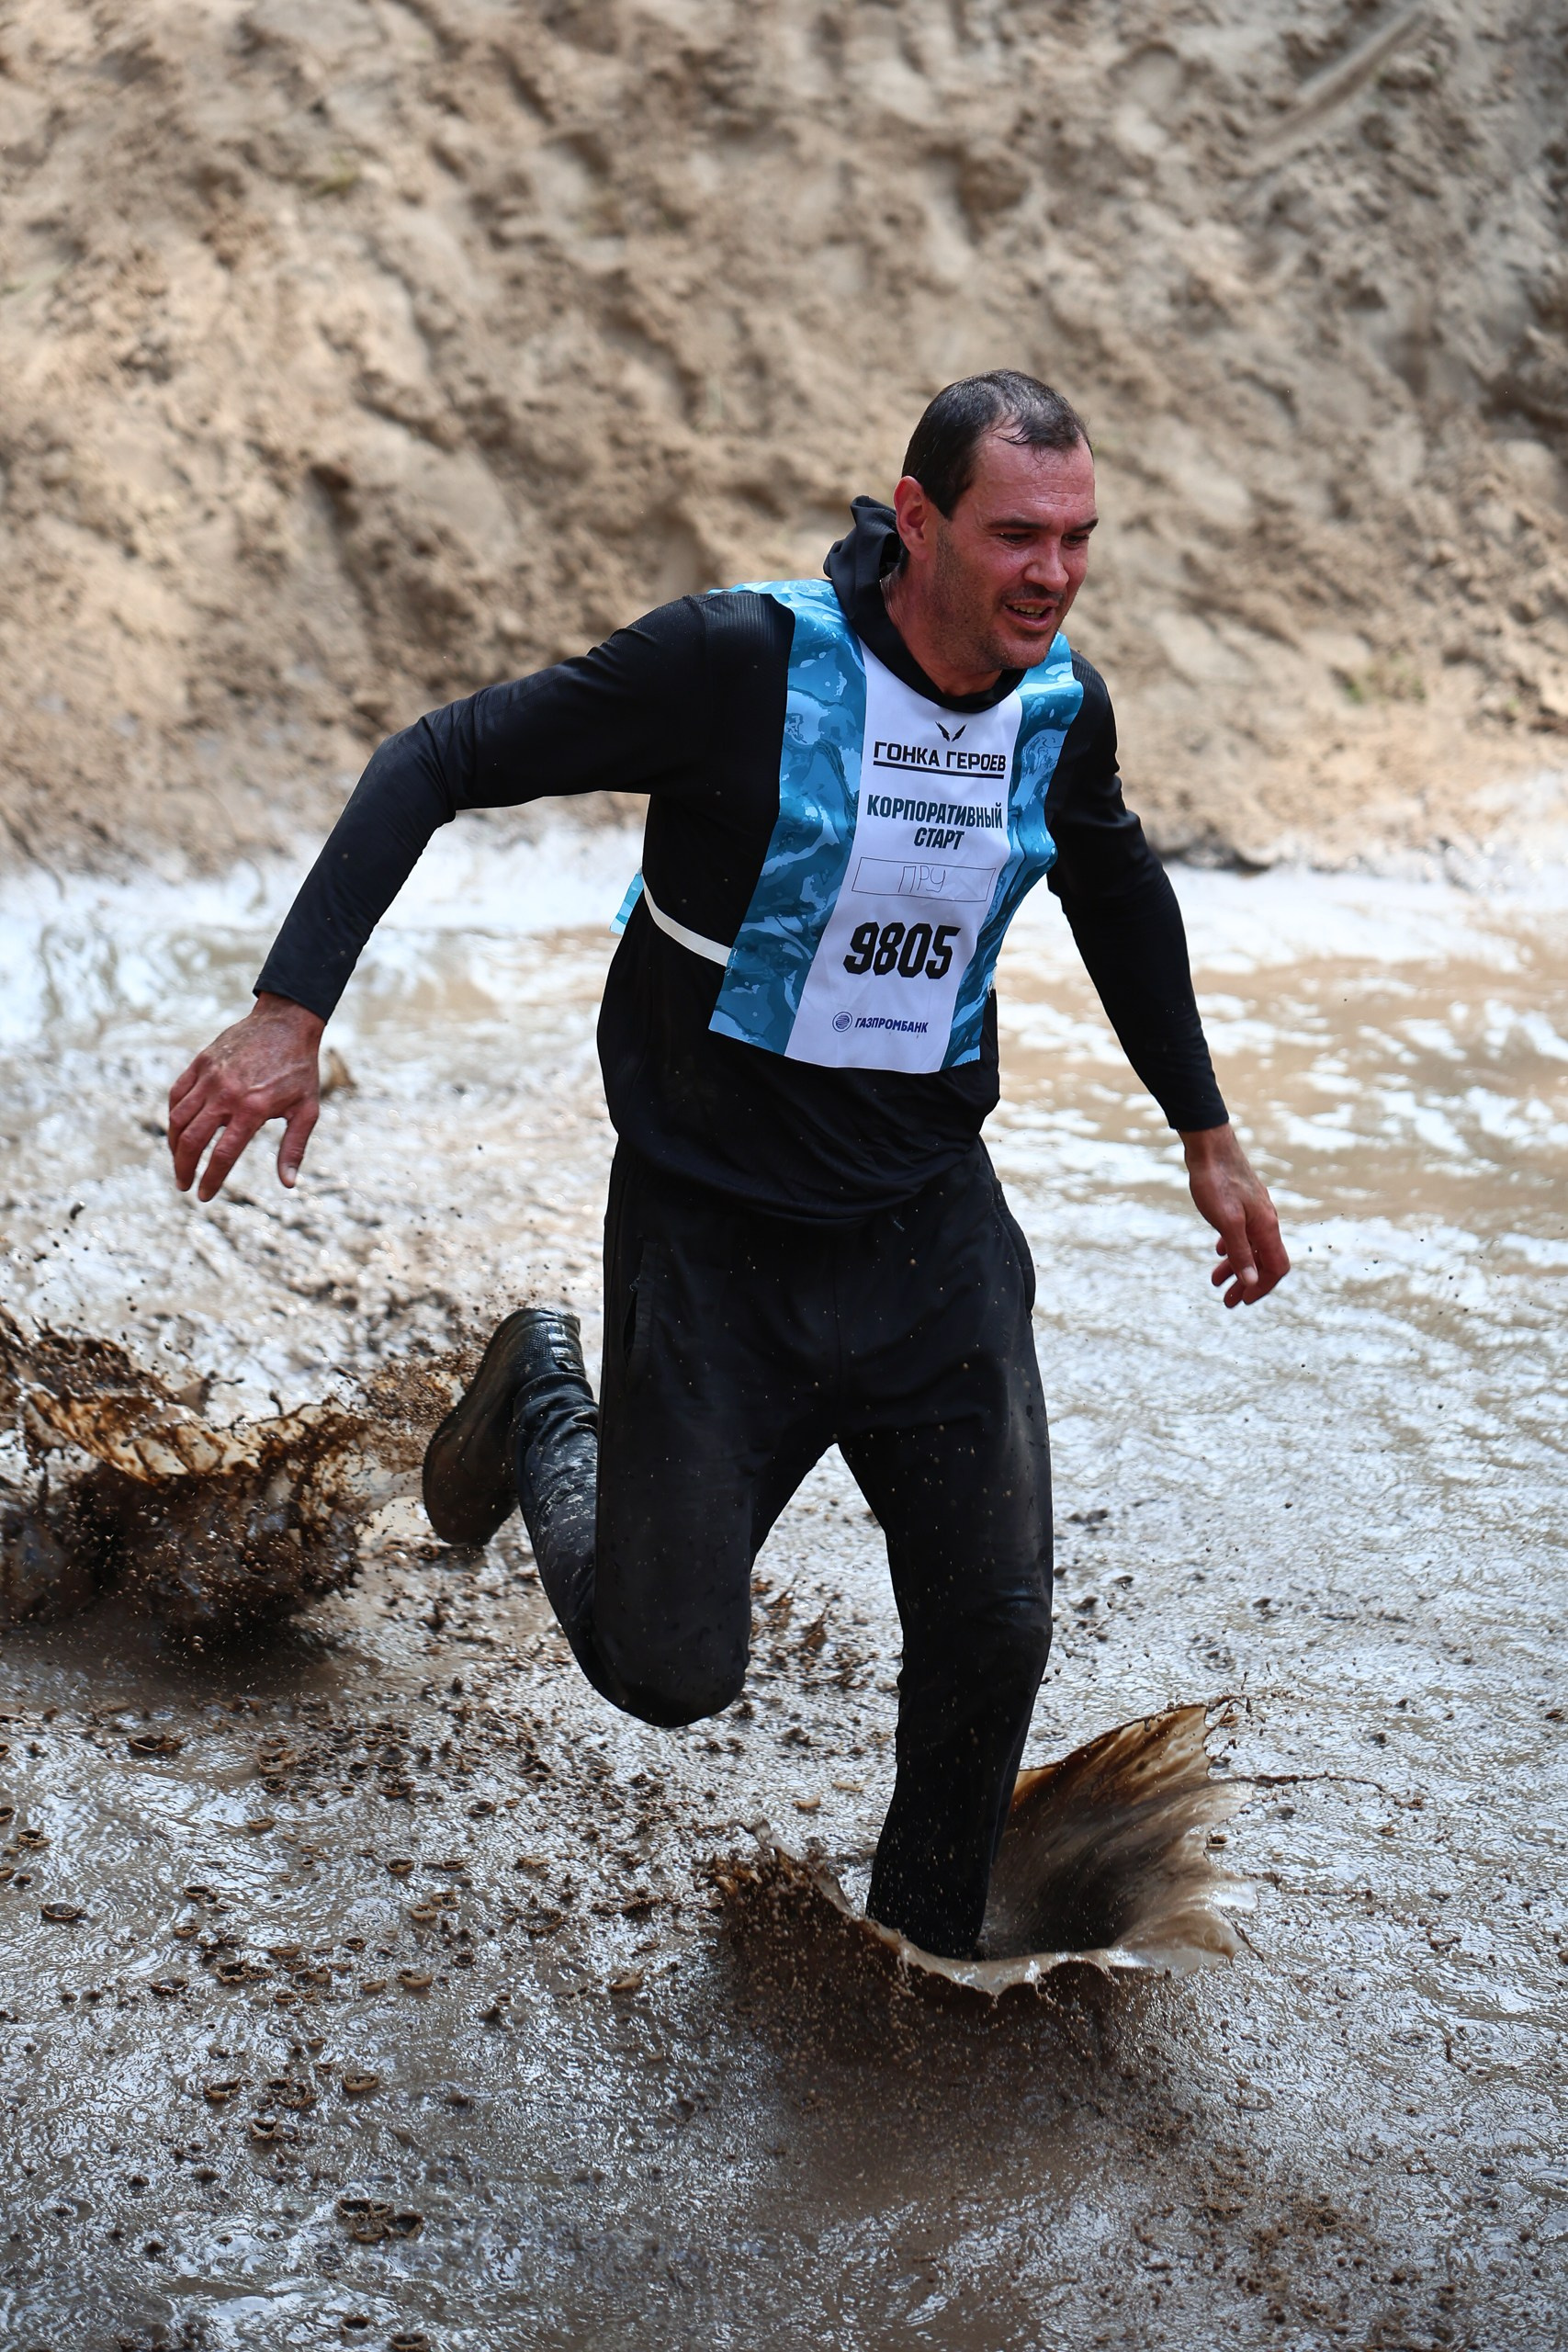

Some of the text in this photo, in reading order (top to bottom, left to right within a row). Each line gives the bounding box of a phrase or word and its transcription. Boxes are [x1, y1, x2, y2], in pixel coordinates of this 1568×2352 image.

[874, 741, 1006, 772] ГОНКА ГЕРОЕВ
[866, 795, 1003, 829] КОРПОРАТИВНЫЙ
[914, 827, 965, 850] СТАРТ
[843, 922, 962, 979] 9805
[854, 1017, 929, 1034] ГАЗПРОМБАНК
